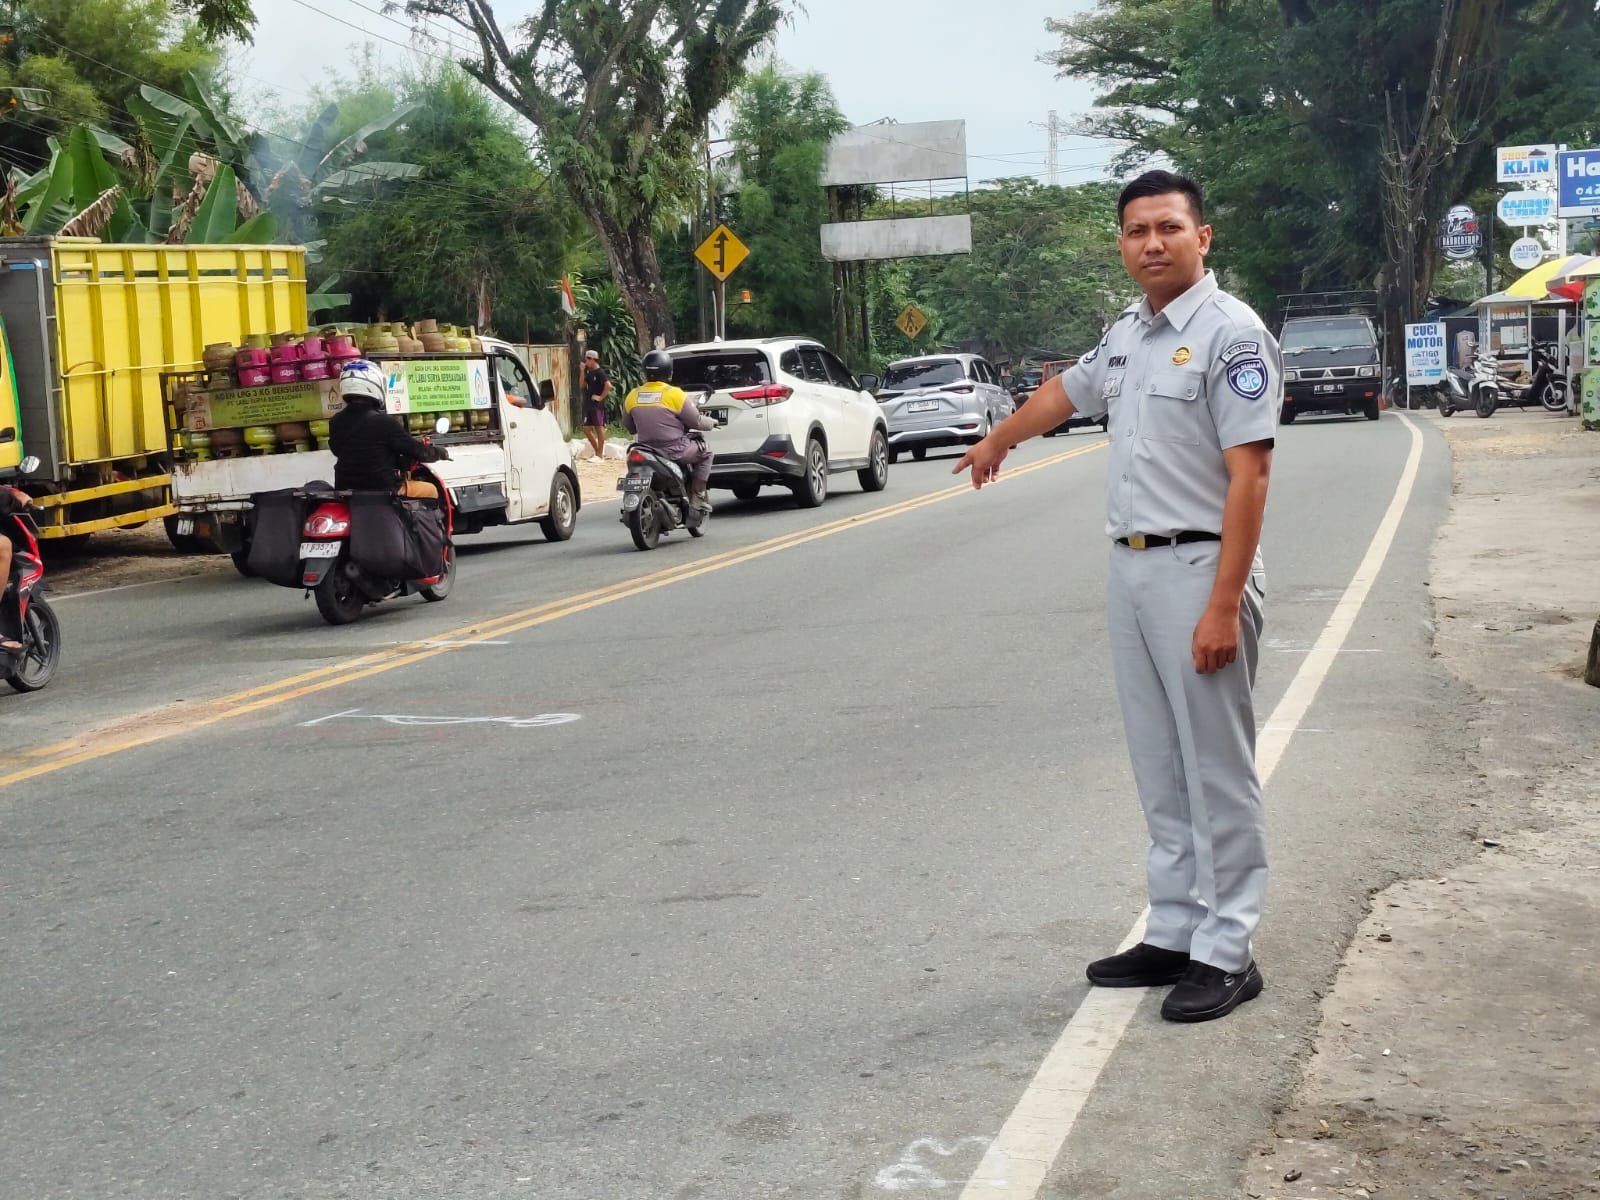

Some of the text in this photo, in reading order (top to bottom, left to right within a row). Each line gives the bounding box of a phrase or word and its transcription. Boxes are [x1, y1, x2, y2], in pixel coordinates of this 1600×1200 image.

[1504, 159, 1549, 174] KLIN
[1412, 325, 1438, 336] CUCI
[1408, 337, 1443, 349] MOTOR
